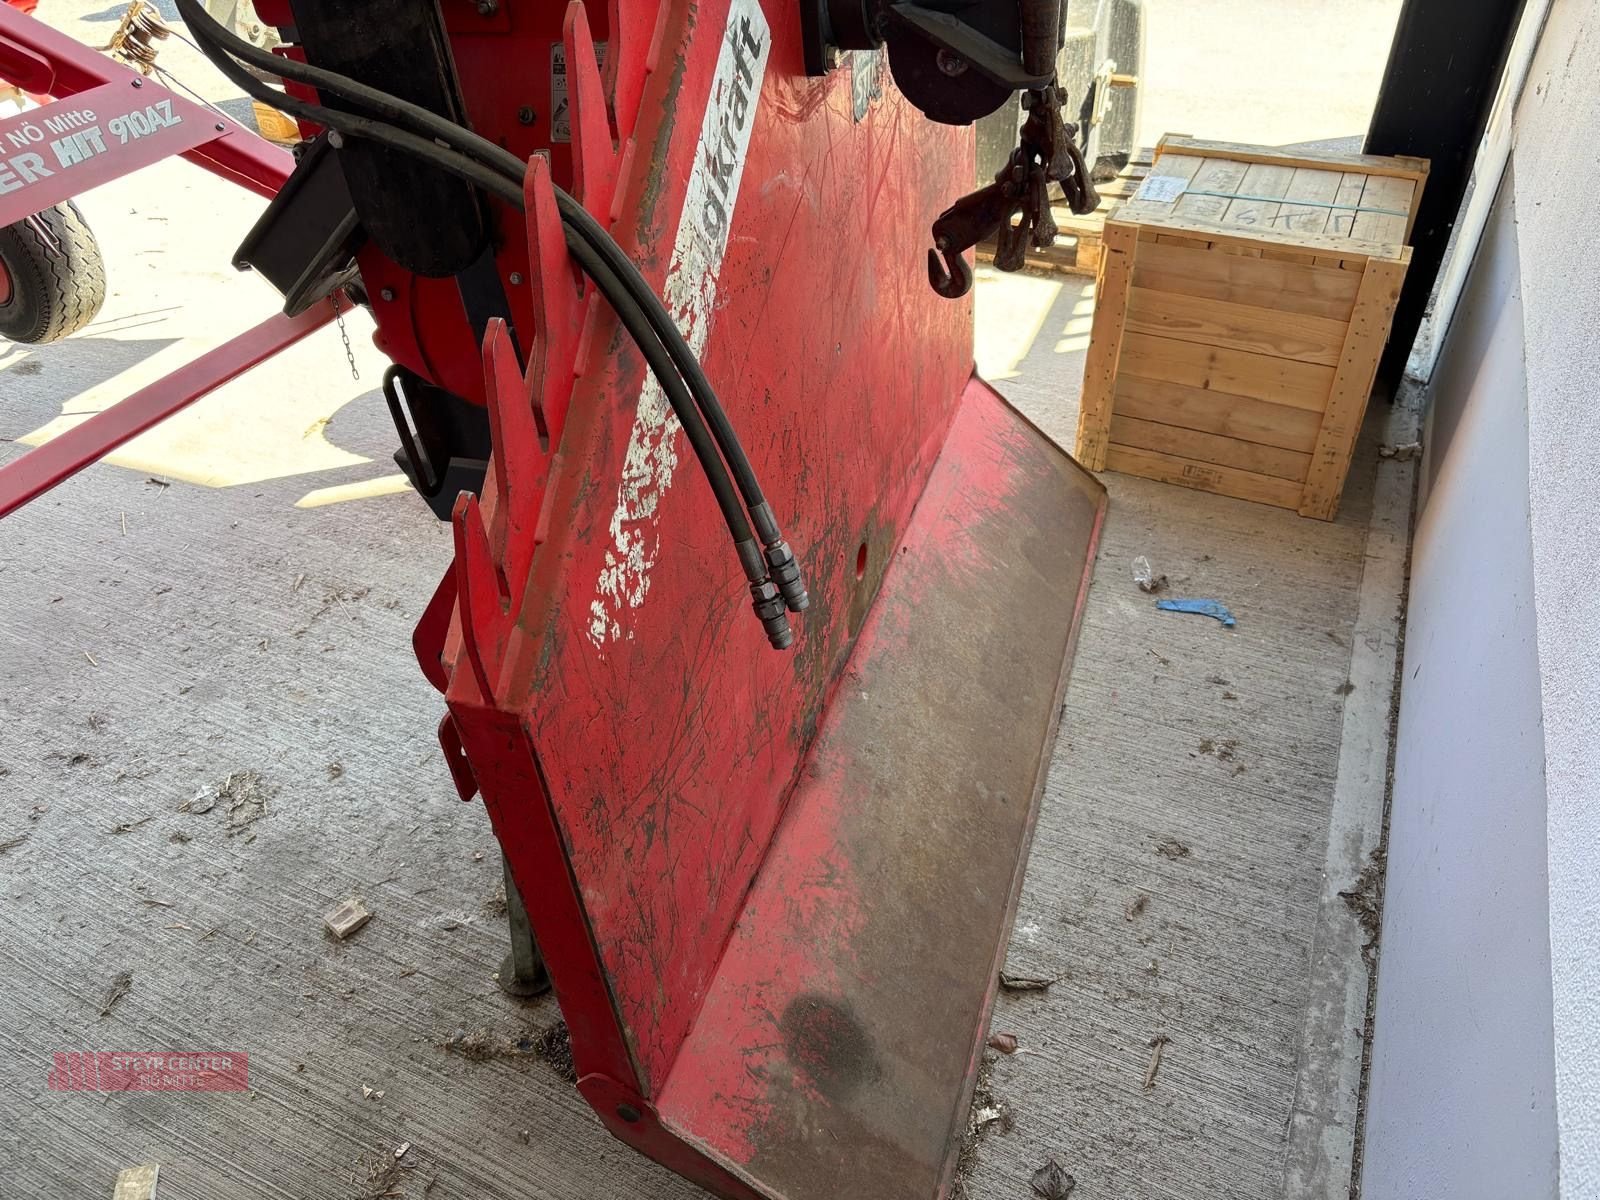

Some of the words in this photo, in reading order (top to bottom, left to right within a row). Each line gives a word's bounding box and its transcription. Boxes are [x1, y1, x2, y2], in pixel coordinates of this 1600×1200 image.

[5, 120, 45, 149] NÖ
[43, 109, 97, 135] Mitte
[50, 126, 108, 169] HIT
[108, 98, 182, 144] 910AZ
